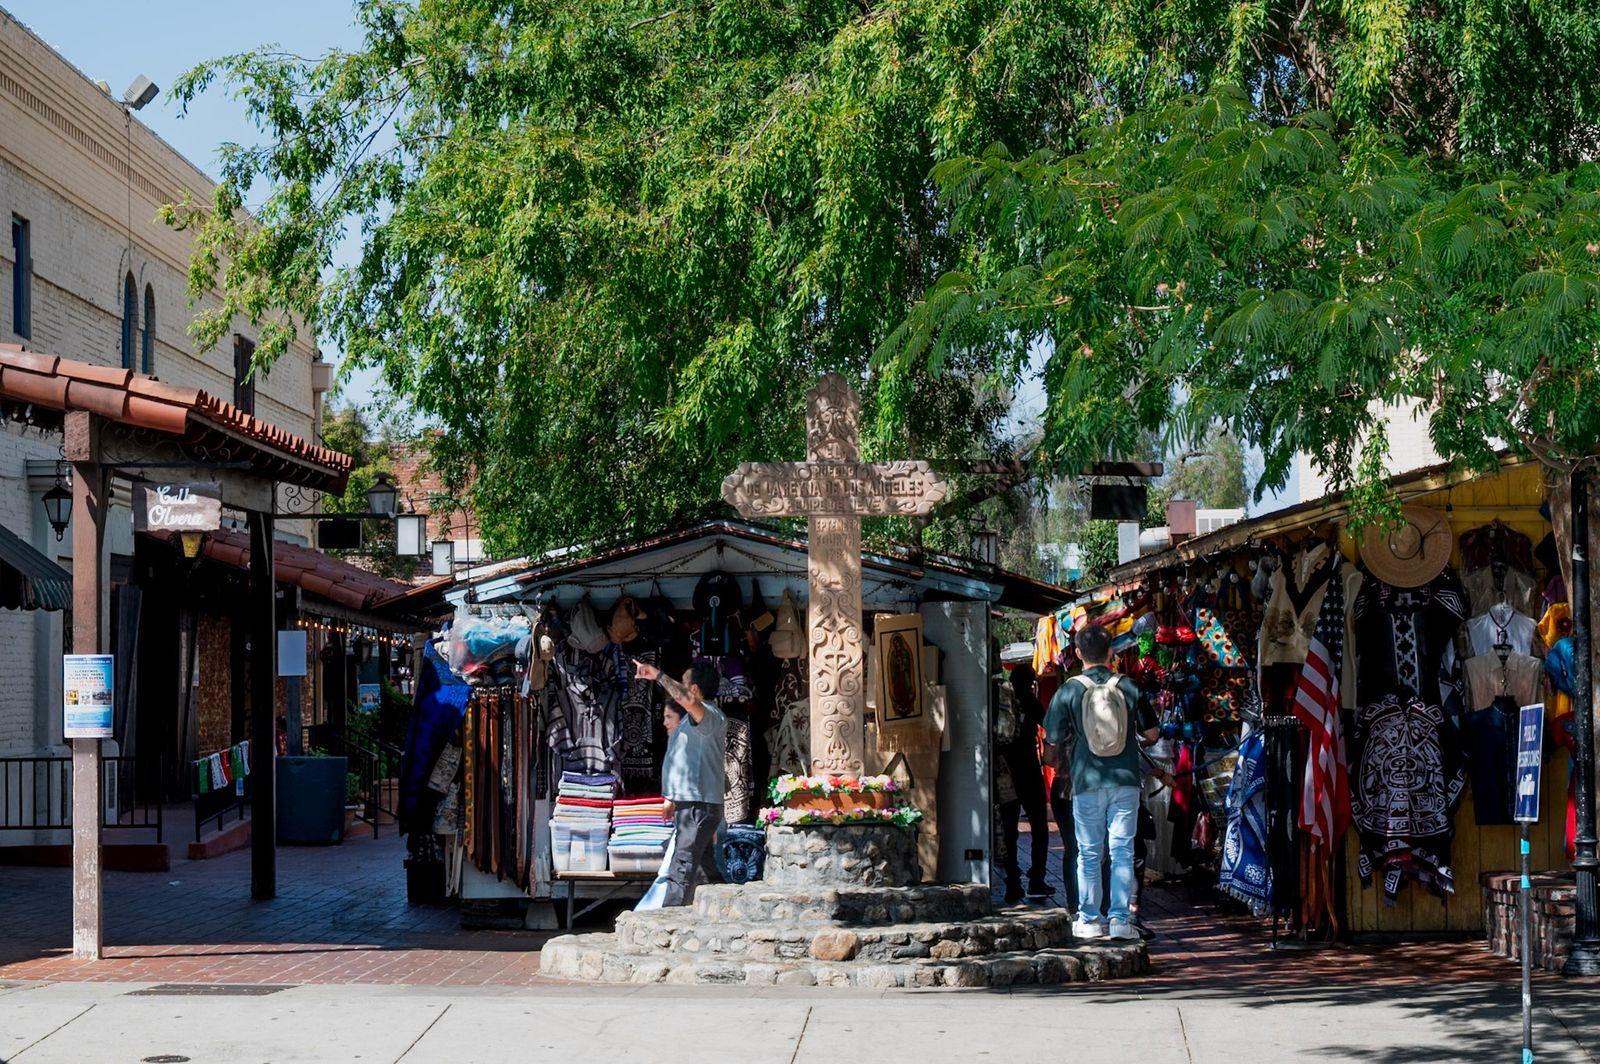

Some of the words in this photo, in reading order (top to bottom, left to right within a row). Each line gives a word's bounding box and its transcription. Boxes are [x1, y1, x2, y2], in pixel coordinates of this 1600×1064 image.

[156, 486, 198, 505] Calle
[745, 481, 760, 497] DE
[764, 480, 781, 497] LA
[825, 480, 840, 497] DE
[841, 480, 865, 497] LOS
[866, 479, 924, 497] ANGELES
[149, 504, 204, 526] Olvera
